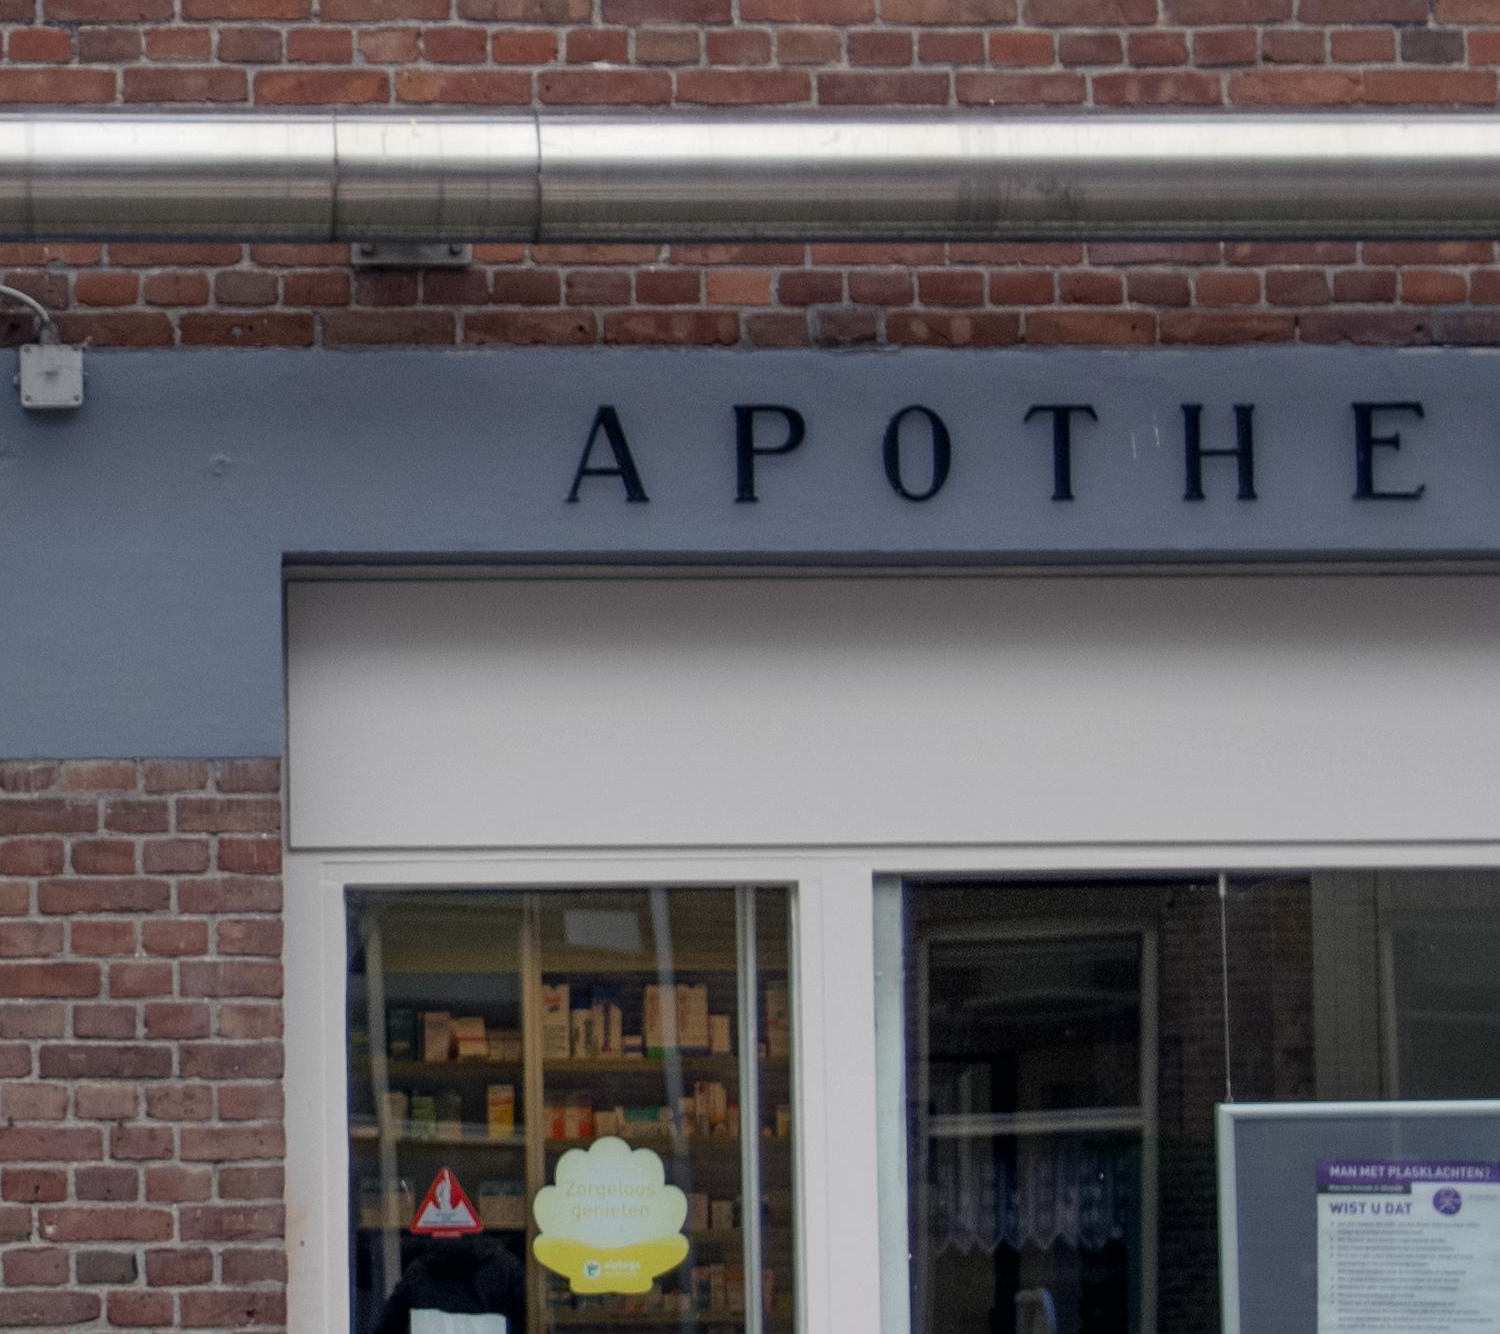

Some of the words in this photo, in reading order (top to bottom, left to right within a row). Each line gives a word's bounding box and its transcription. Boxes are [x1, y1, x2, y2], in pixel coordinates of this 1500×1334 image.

[1329, 1166, 1357, 1178] MAN
[1360, 1166, 1385, 1178] MET
[565, 1180, 656, 1200] Zorgeloos
[571, 1203, 649, 1223] genieten
[1330, 1202, 1366, 1215] WIST
[1371, 1202, 1381, 1215] U
[1385, 1202, 1413, 1215] DAT
